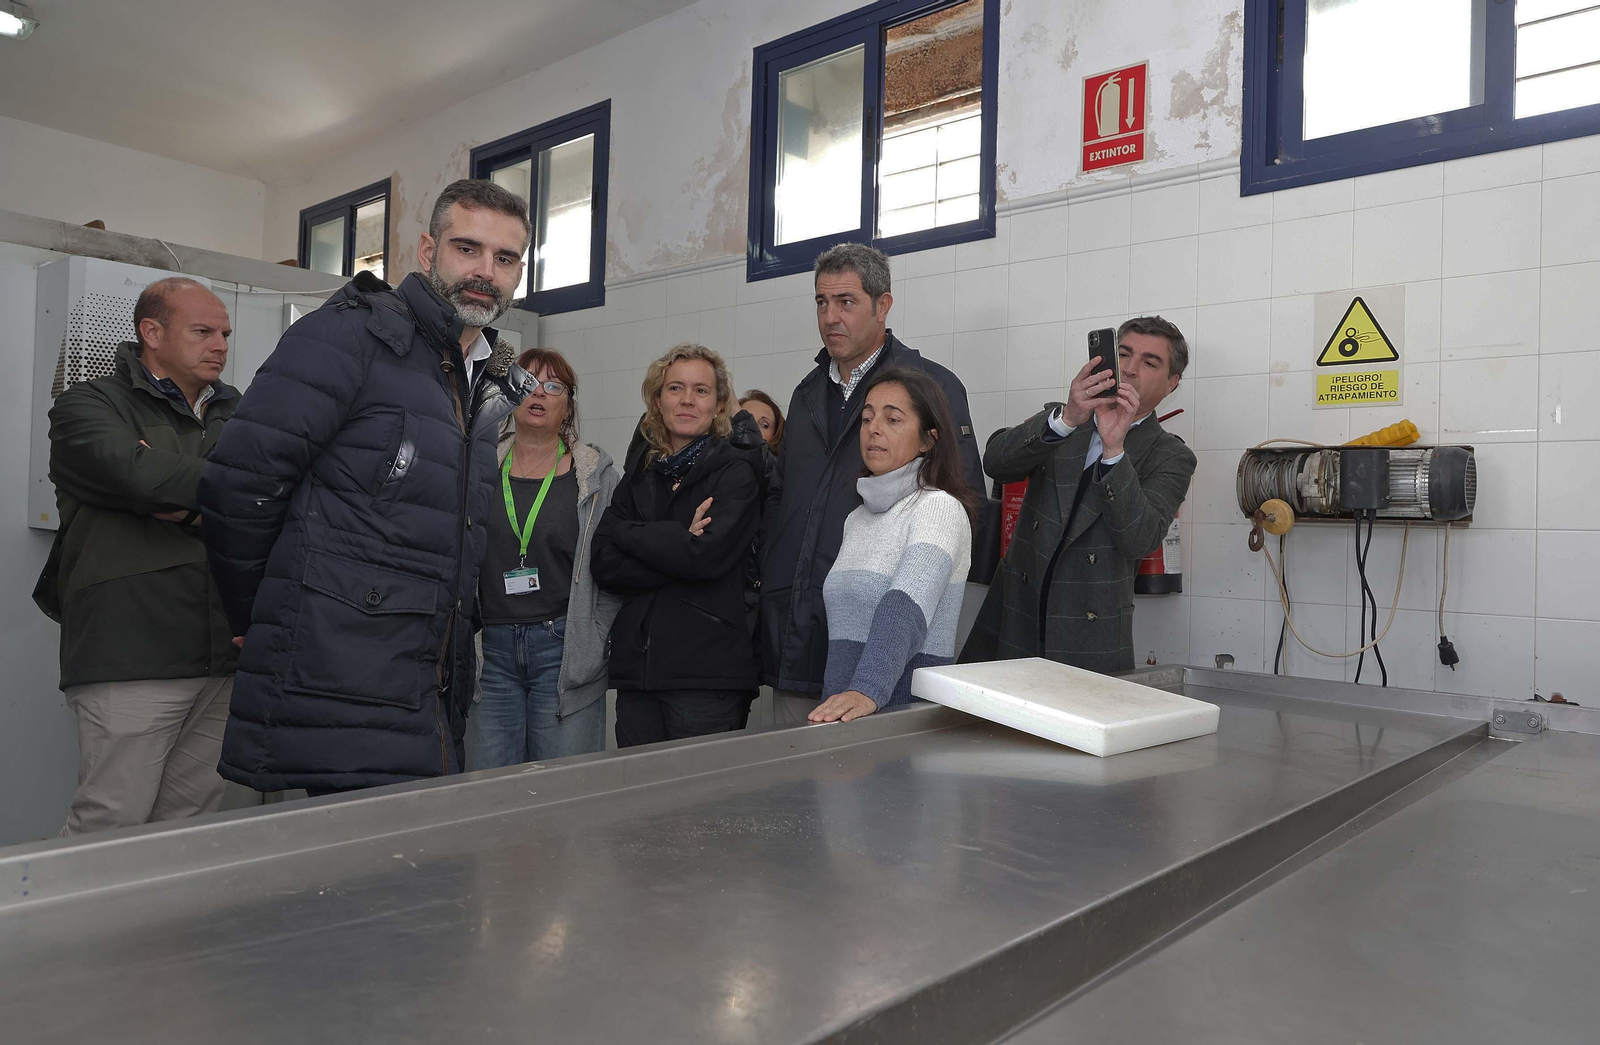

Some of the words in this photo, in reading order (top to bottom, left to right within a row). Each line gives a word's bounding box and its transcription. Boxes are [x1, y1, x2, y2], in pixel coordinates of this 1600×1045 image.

[1089, 144, 1136, 161] EXTINTOR
[1332, 373, 1382, 384] ¡PELIGRO!
[1330, 383, 1368, 392] RIESGO
[1370, 382, 1384, 390] DE
[1318, 390, 1396, 401] ATRAPAMIENTO
